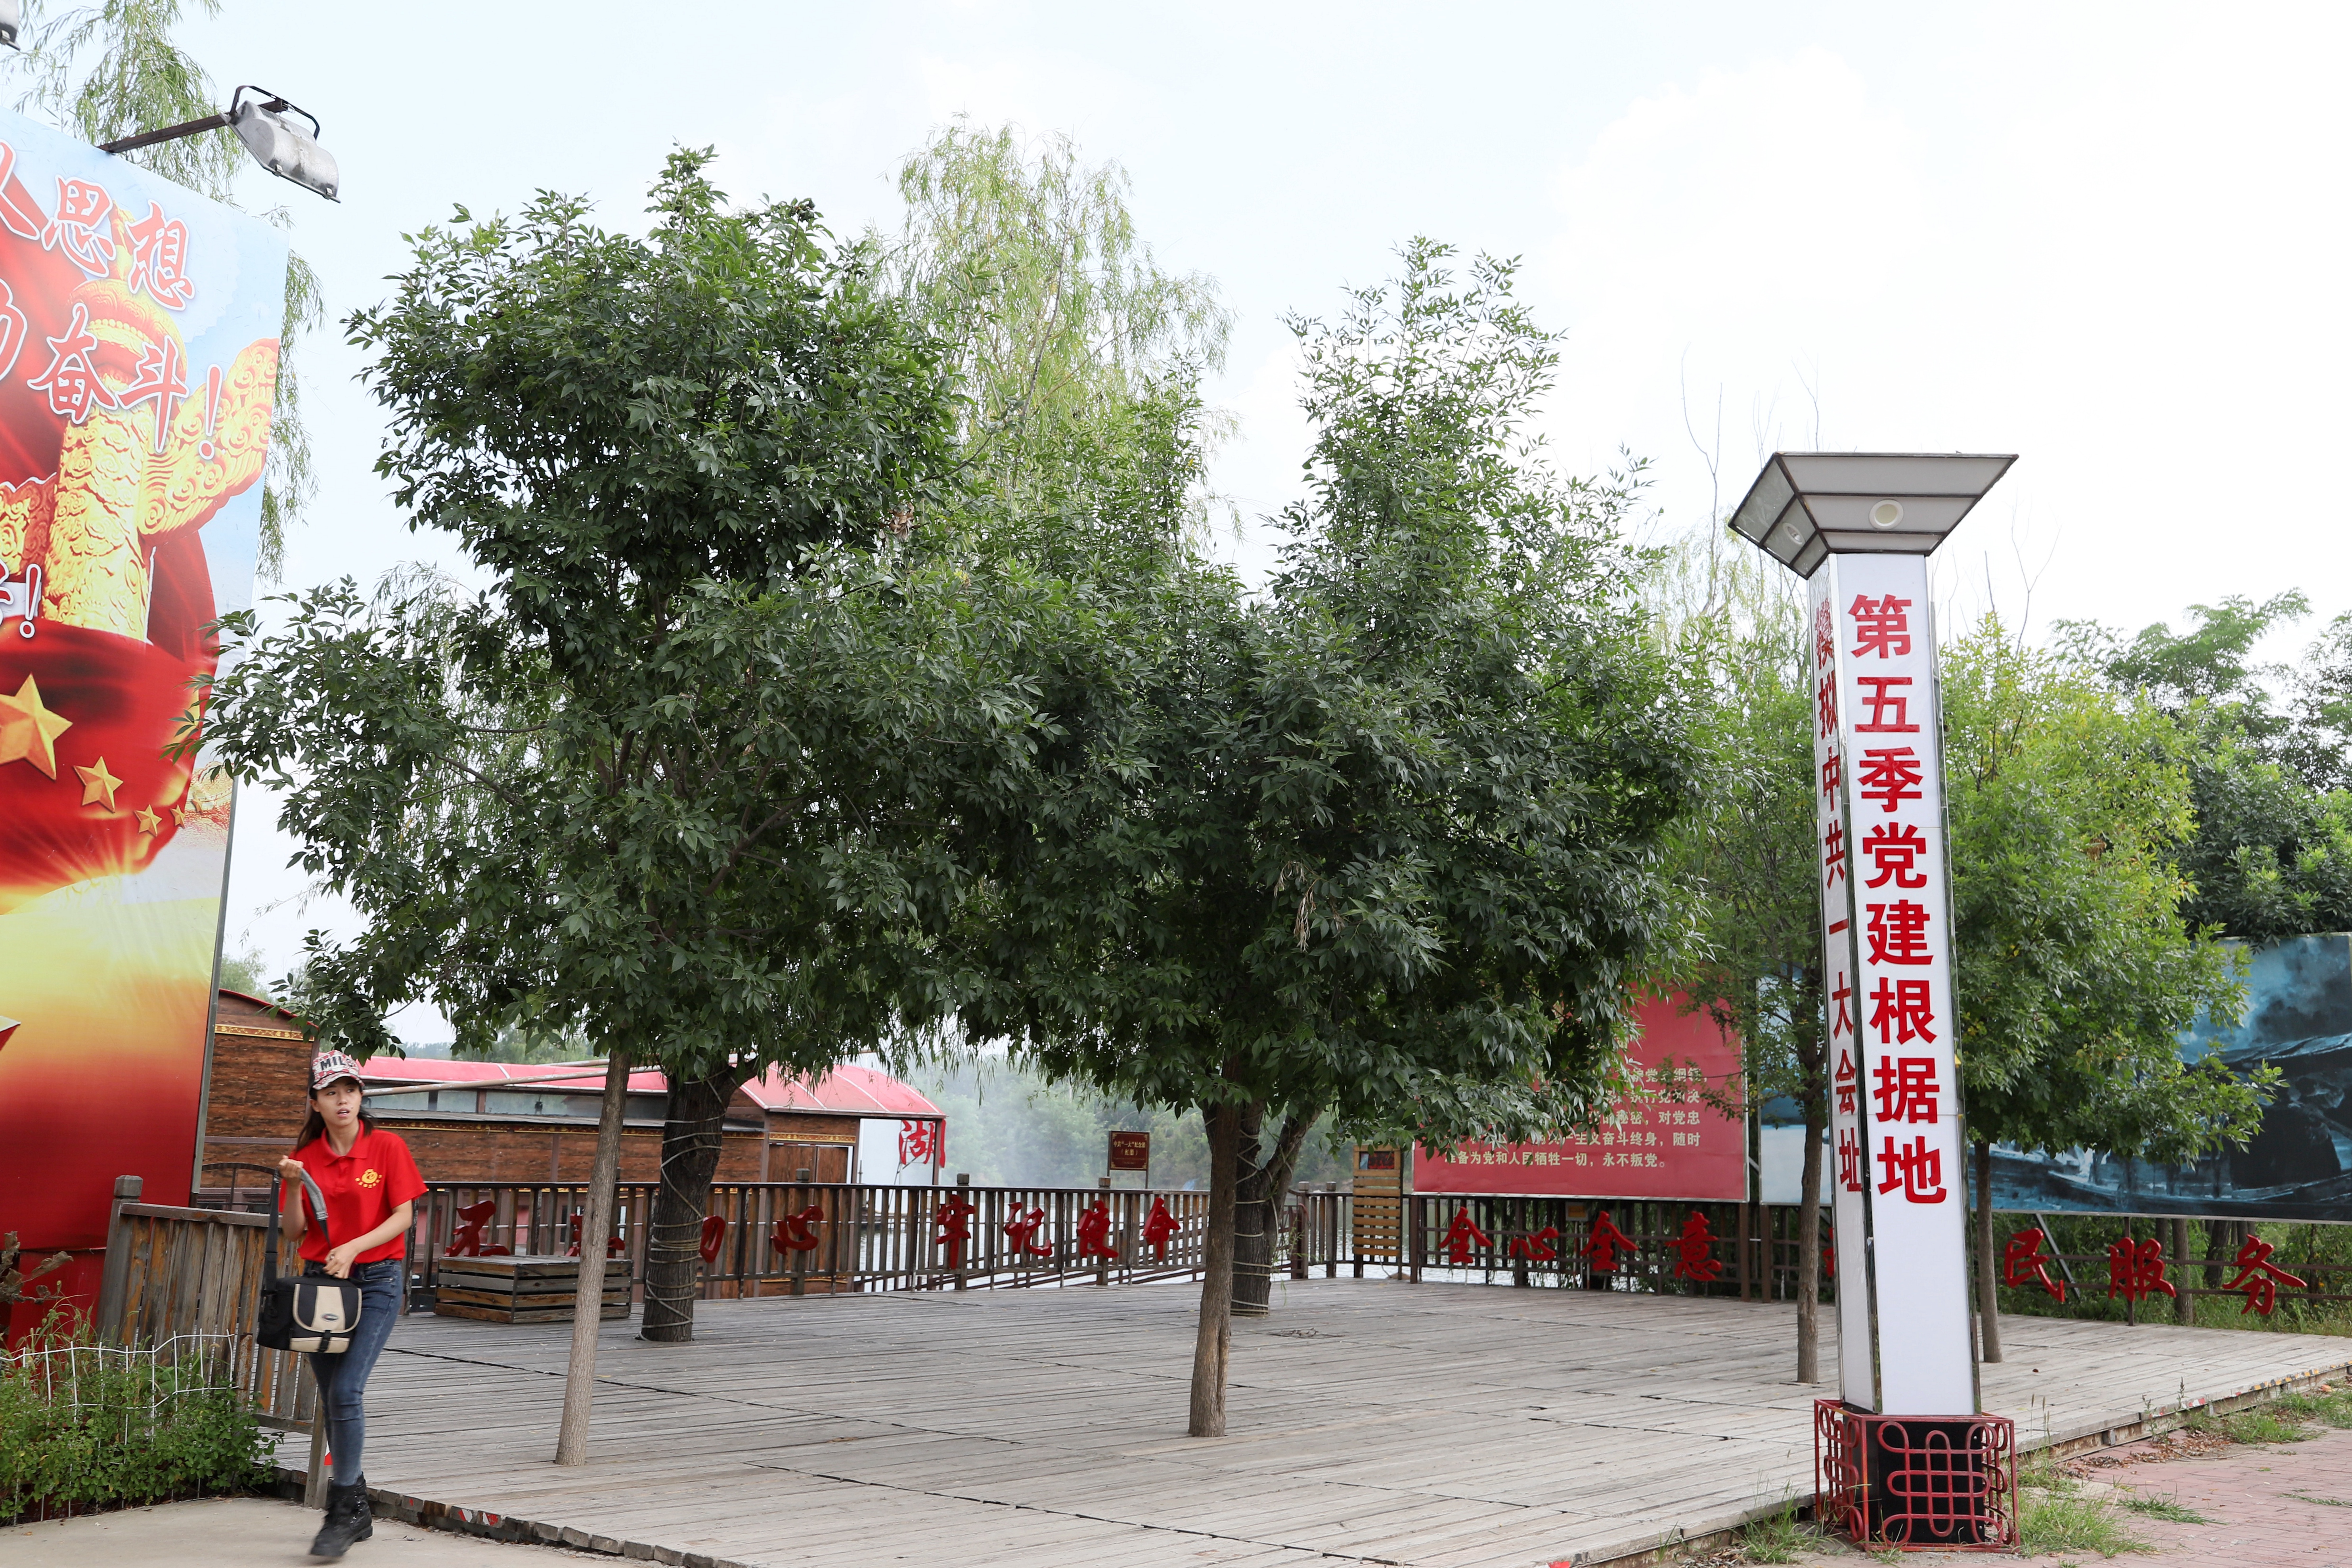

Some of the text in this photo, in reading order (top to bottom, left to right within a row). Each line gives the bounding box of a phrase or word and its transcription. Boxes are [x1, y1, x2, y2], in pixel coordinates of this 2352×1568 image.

[1848, 594, 1947, 1204] 第五季党建根据地
[899, 1119, 946, 1168] 湖
